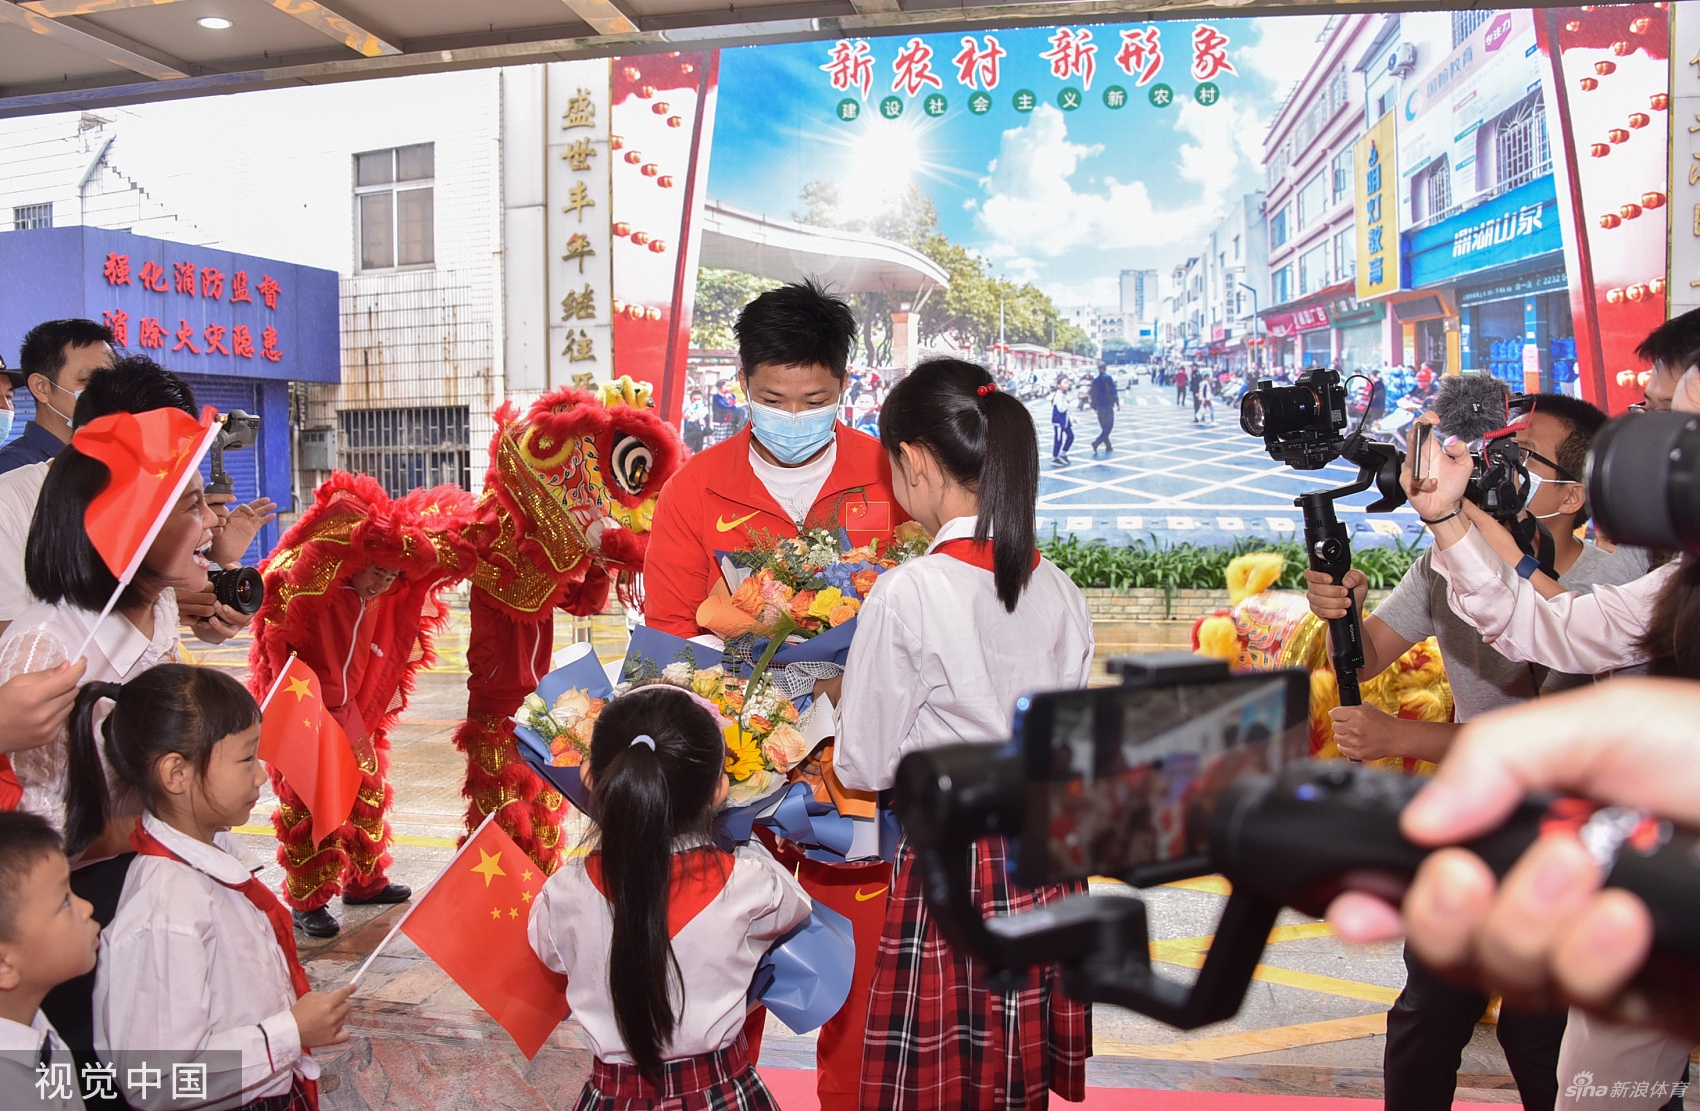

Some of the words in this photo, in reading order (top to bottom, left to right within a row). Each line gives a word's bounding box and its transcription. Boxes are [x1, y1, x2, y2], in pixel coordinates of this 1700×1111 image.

[821, 37, 1004, 99] 新农村
[1042, 26, 1234, 89] 新形象
[839, 83, 1221, 120] 建设社会主义新农村
[1366, 163, 1385, 287] 明灯教育
[103, 252, 283, 311] 强化消防监督
[103, 308, 284, 362] 消除火灾隐患
